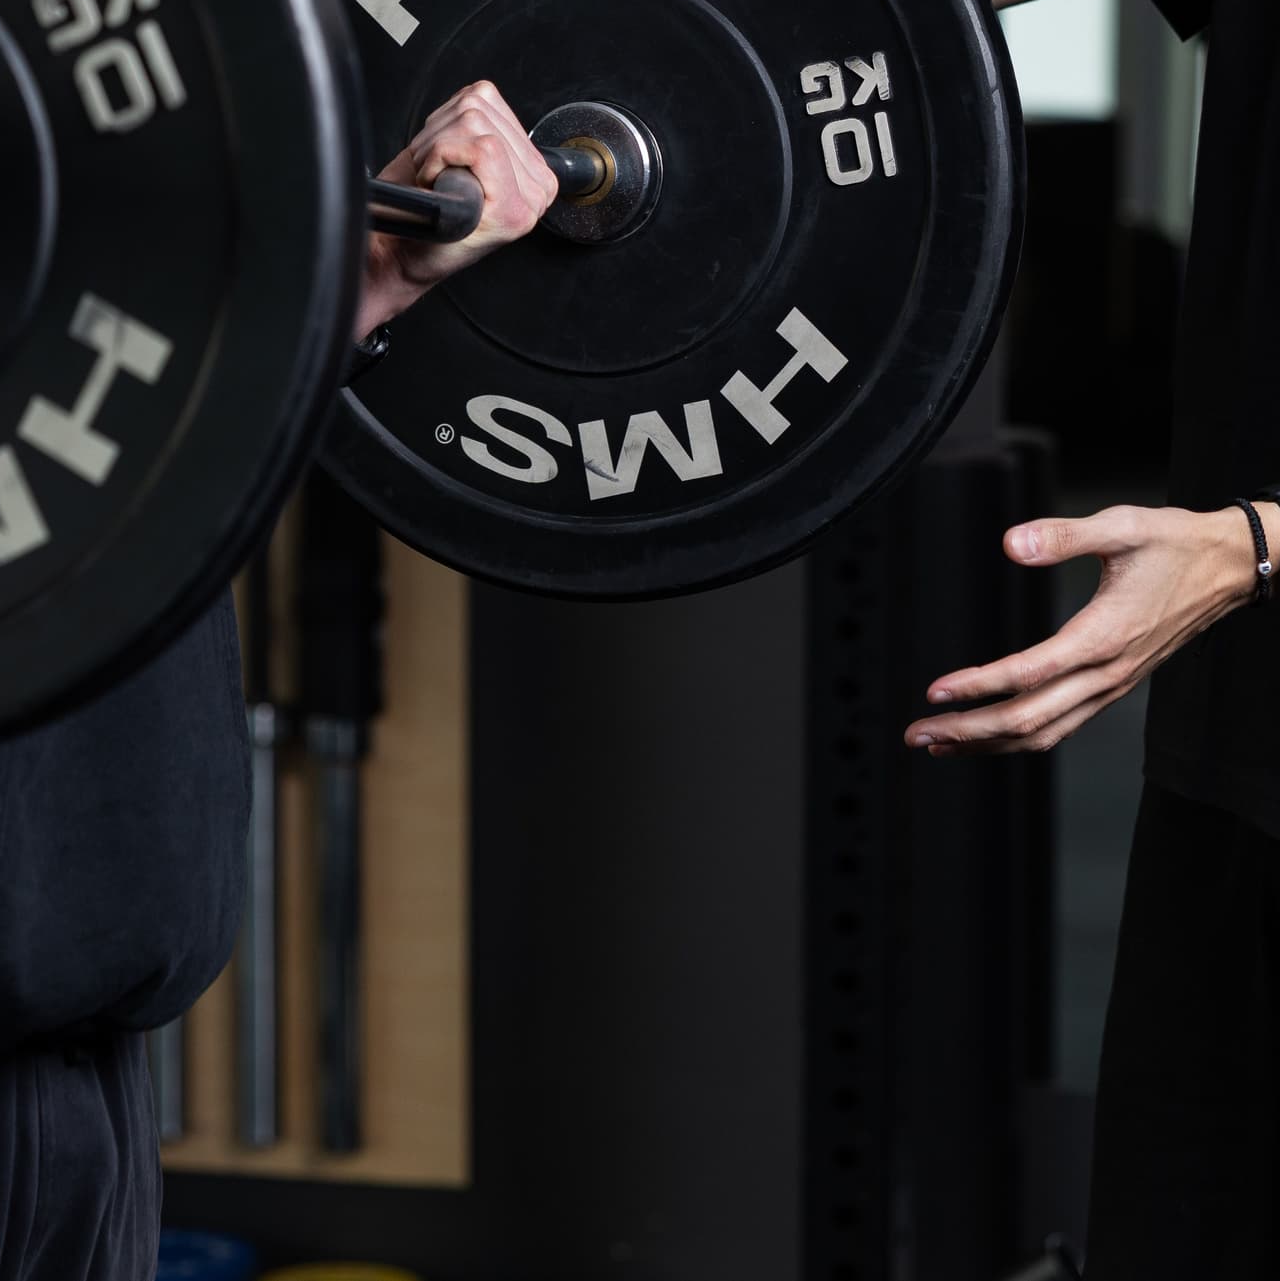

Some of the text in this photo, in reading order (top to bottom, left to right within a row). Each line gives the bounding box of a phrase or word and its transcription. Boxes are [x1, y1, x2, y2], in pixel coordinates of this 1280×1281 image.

[72, 20, 188, 134] 10
[799, 51, 892, 116] KG
[820, 111, 899, 186] 10
